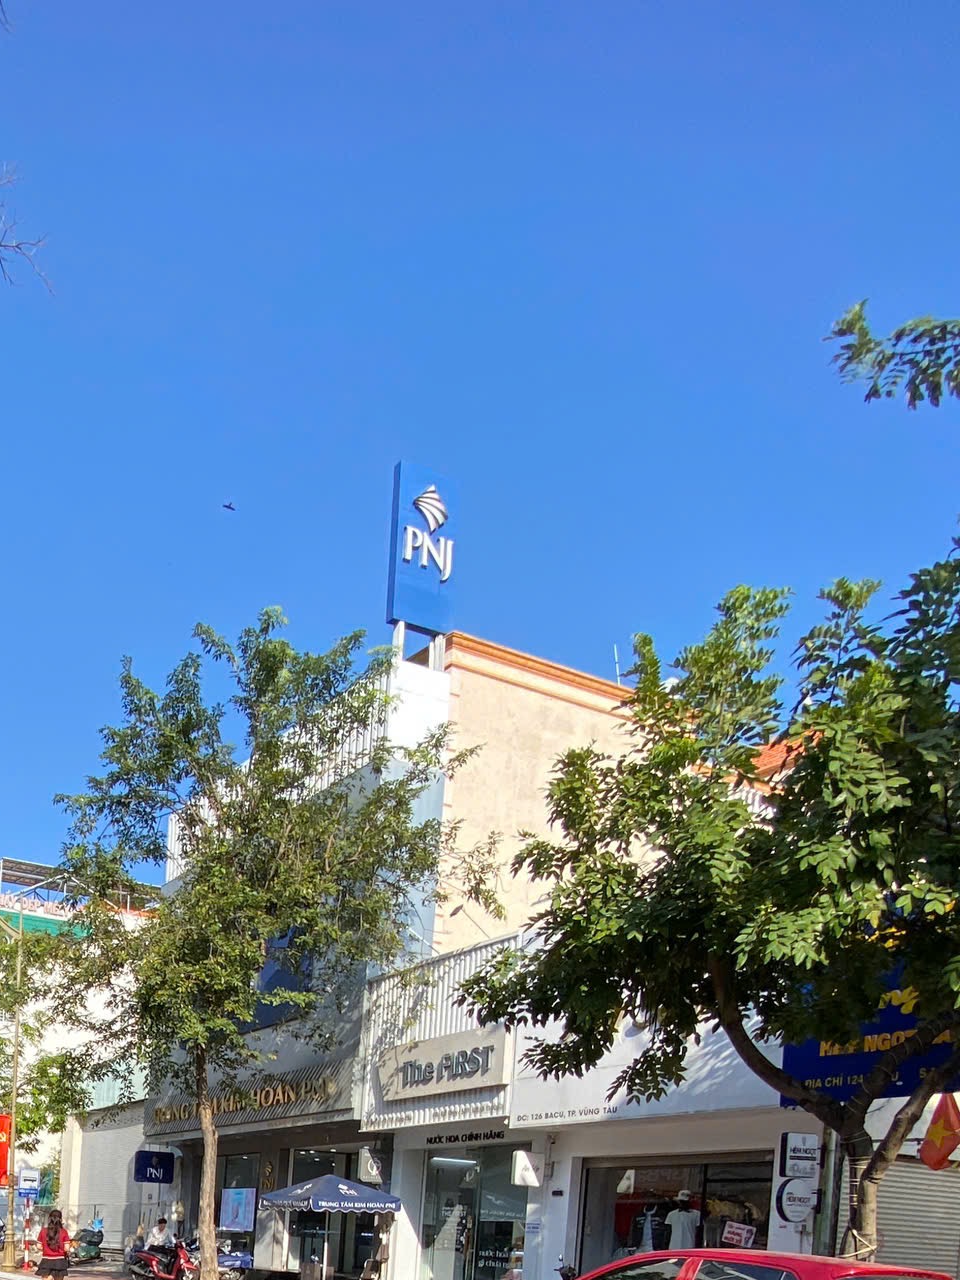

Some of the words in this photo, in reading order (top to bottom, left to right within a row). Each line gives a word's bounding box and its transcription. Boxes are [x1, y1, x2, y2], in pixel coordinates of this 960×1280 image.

[402, 525, 454, 583] PNJ
[399, 1059, 434, 1088] The
[437, 1045, 494, 1083] FIRST
[531, 1113, 543, 1121] 126
[146, 1167, 163, 1180] PNJ
